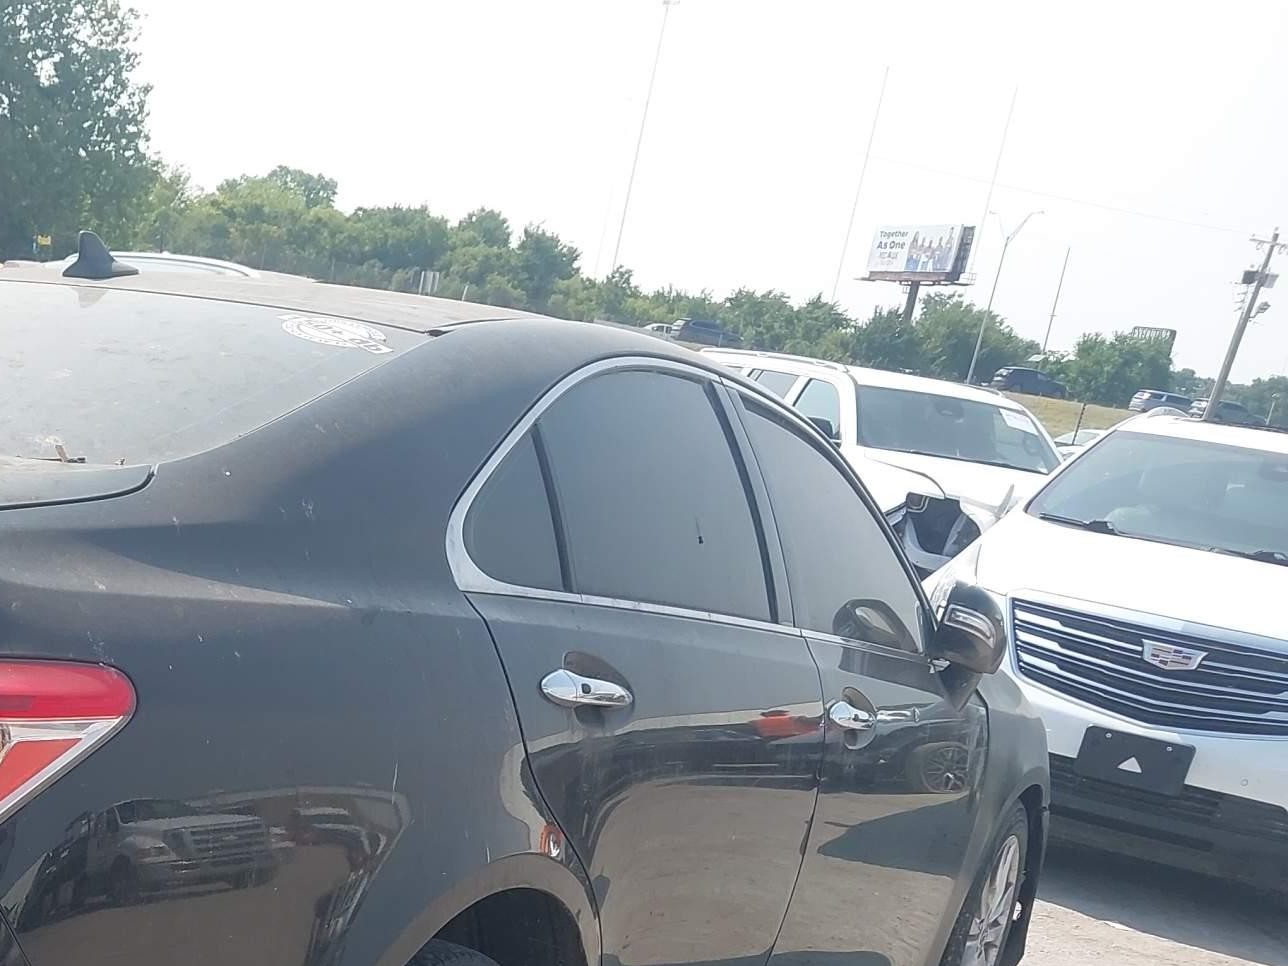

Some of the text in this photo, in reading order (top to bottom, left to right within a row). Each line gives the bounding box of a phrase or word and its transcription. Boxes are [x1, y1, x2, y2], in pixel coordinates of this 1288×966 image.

[880, 231, 909, 239] Together
[877, 241, 906, 249] As One
